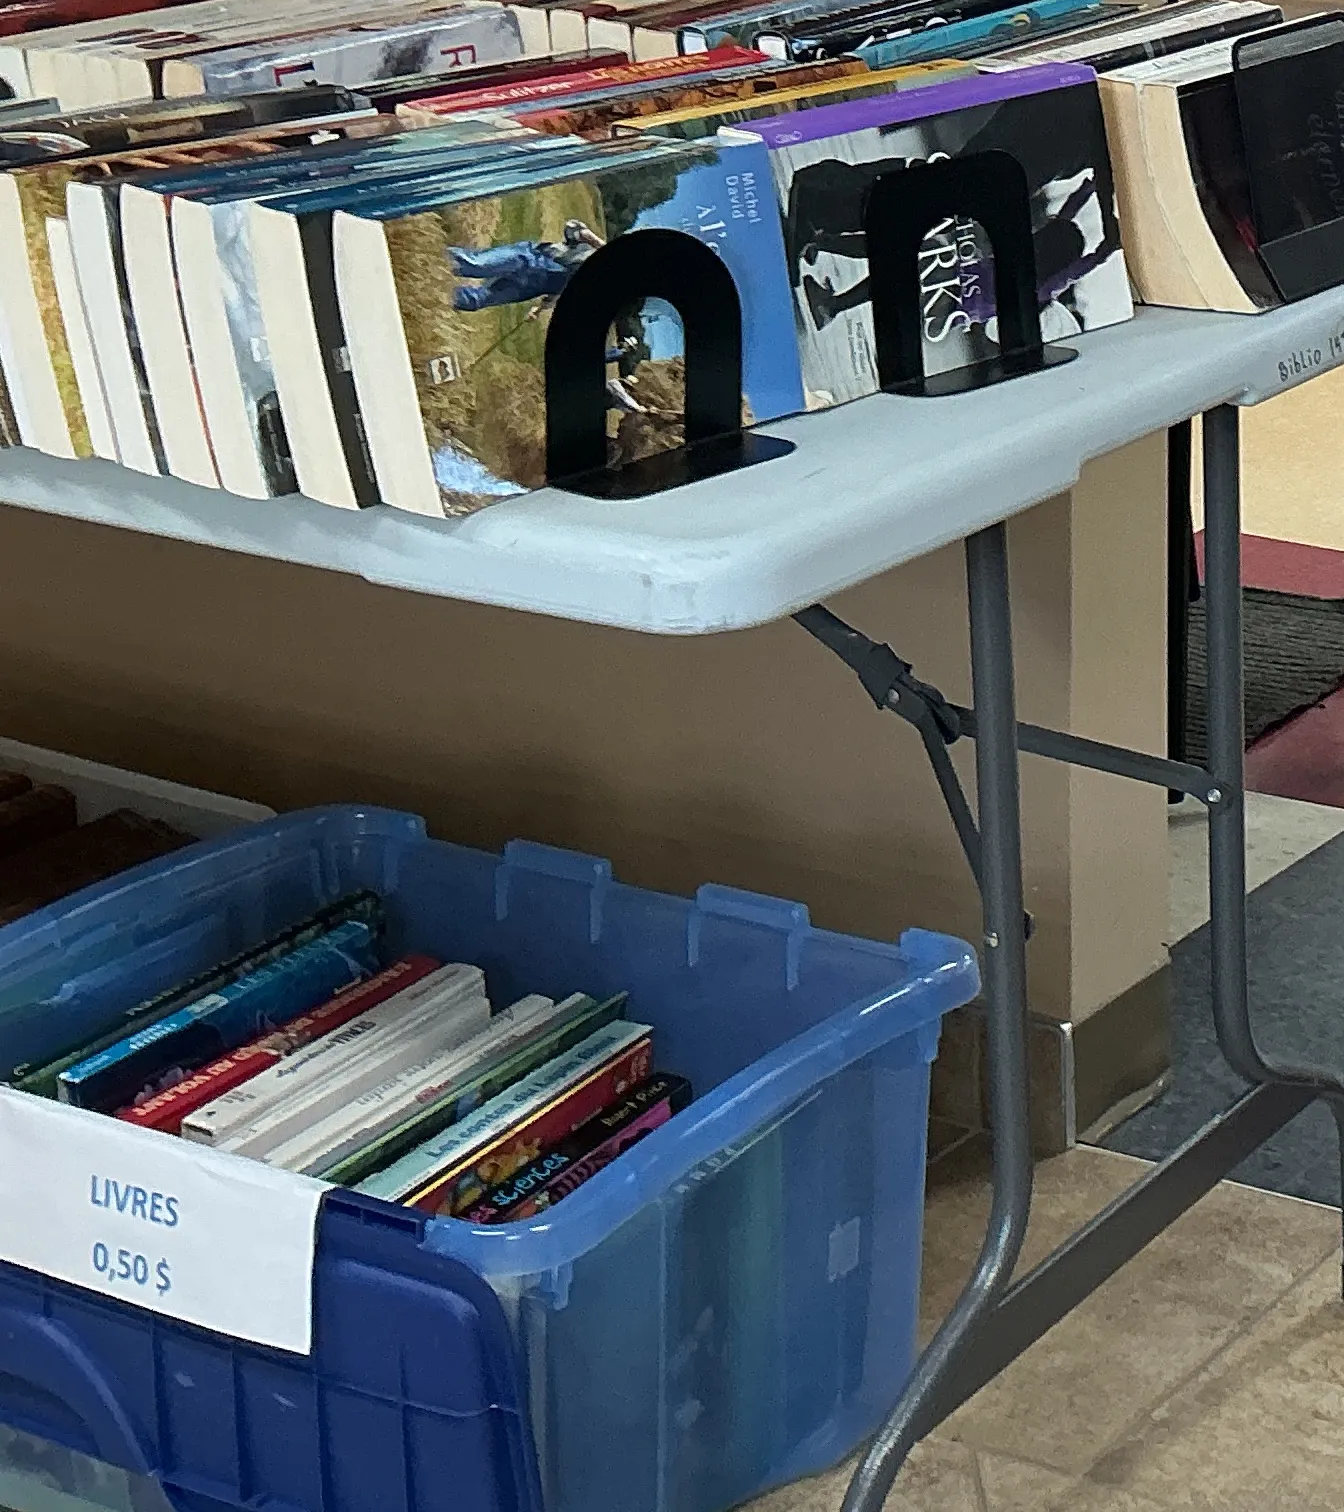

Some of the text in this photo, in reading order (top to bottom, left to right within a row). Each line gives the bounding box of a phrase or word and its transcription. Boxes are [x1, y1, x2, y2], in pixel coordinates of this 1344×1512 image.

[725, 175, 745, 220] David
[741, 171, 763, 225] Michel
[917, 217, 972, 344] ARKS
[1278, 348, 1322, 383] Biblio
[91, 1174, 179, 1227] LIVRES
[491, 1149, 572, 1207] sciences
[93, 1241, 172, 1297] 0,50 $
